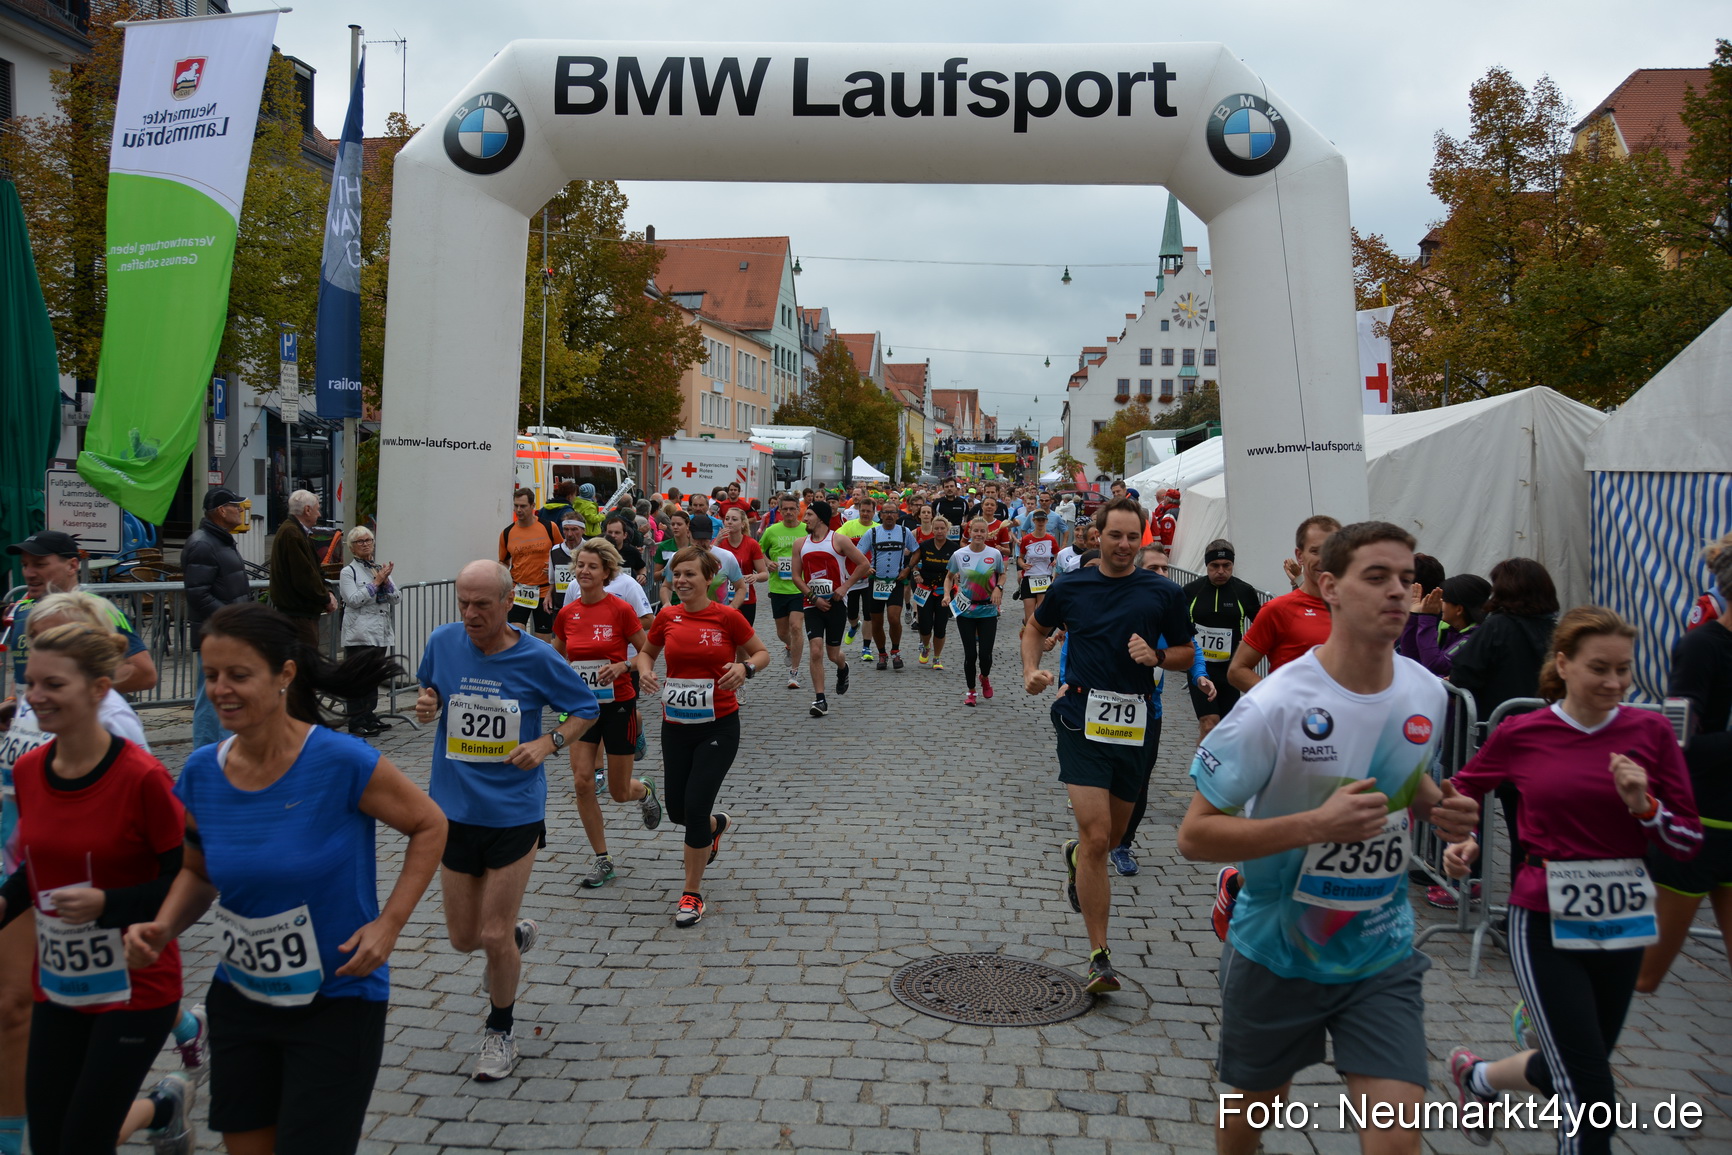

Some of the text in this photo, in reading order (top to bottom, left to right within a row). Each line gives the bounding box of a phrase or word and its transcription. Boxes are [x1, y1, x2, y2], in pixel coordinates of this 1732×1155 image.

[554, 55, 1178, 134] BMW Laufsport
[453, 94, 520, 121] BMW
[1213, 95, 1282, 122] BMW
[216, 384, 224, 414] P
[243, 434, 249, 447] 3
[382, 436, 492, 451] www.bmw-laufsport.de
[1246, 440, 1363, 457] www.bmw-laufsport.de
[50, 479, 87, 489] Fußgänger
[59, 500, 110, 509] Kreuzung über
[73, 510, 97, 518] Untere
[63, 519, 107, 529] Kaserngasse
[518, 589, 535, 599] 170
[875, 581, 894, 592] 2823
[1201, 635, 1224, 650] 176
[667, 689, 707, 707] 2461
[450, 701, 508, 713] PARTL Neumarkt
[1098, 702, 1136, 724] 219
[461, 712, 506, 739] 320
[1095, 726, 1133, 738] Johannes
[461, 742, 504, 754] Reinhard
[1302, 746, 1337, 755] PARTL
[1315, 836, 1403, 874] 2356
[1550, 869, 1633, 879] PARTL Neumarkt
[1321, 881, 1385, 898] Bernhard
[1561, 882, 1647, 917] 2305
[40, 932, 114, 972] 2555
[223, 930, 307, 973] 2359
